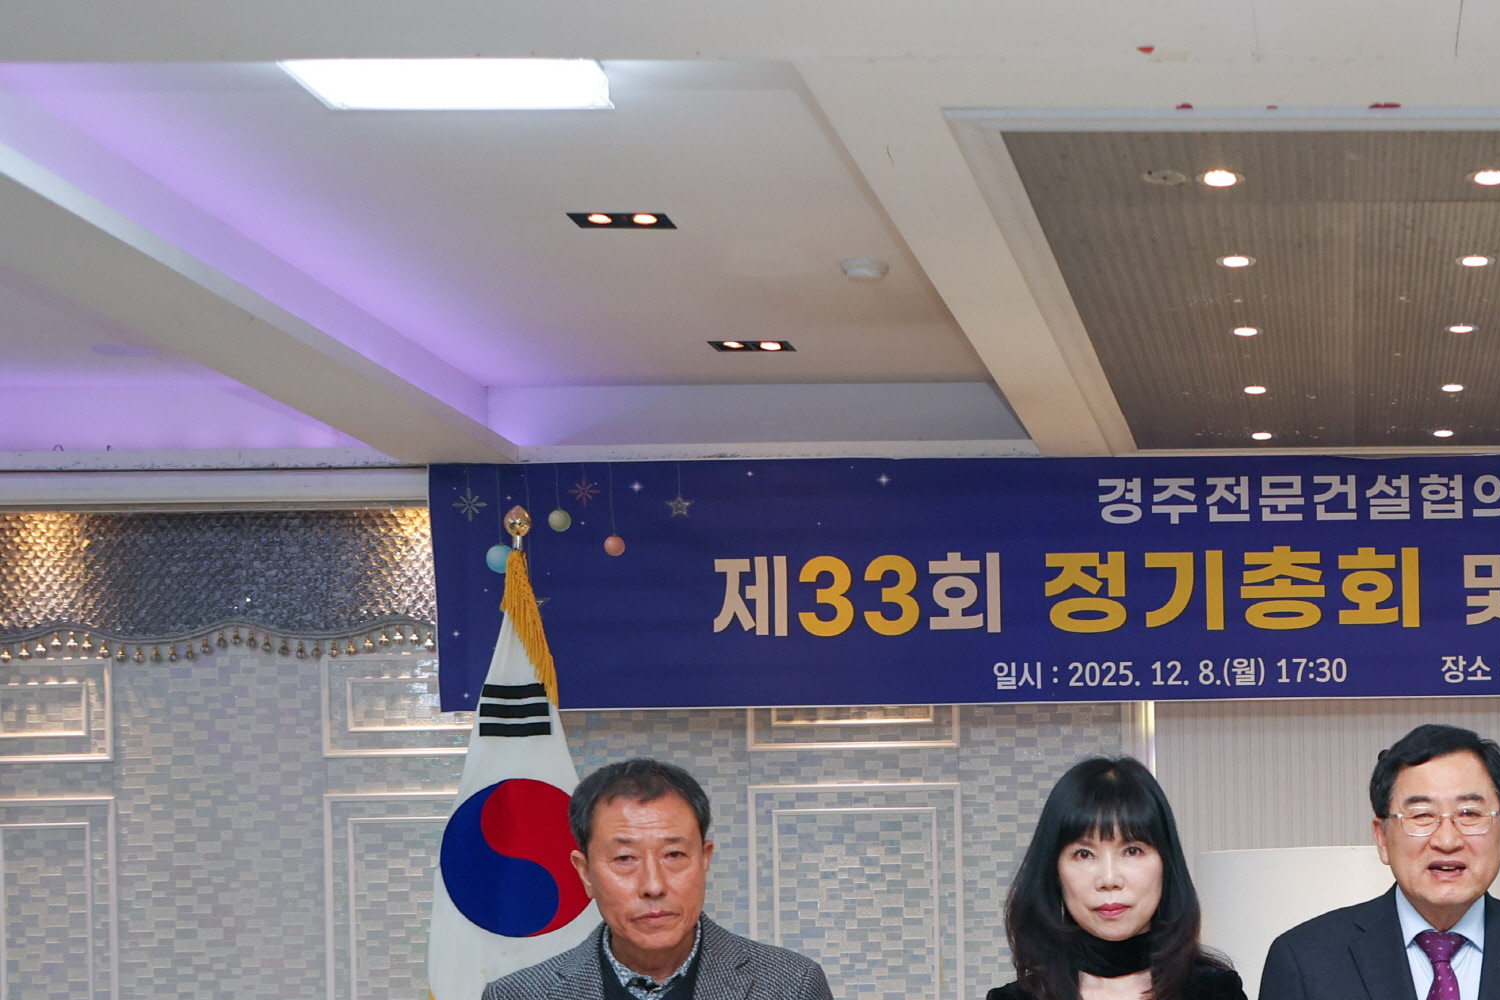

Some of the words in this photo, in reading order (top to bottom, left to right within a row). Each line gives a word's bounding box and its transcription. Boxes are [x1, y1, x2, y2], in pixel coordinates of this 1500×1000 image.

[714, 552, 1001, 636] 제33회
[1045, 546, 1420, 633] 정기총회
[993, 662, 1041, 689] 일시
[1068, 662, 1140, 686] 2025.
[1152, 661, 1189, 685] 12.
[1199, 658, 1264, 686] 8.(월)
[1277, 658, 1346, 682] 17:30
[1441, 656, 1491, 683] 장소
